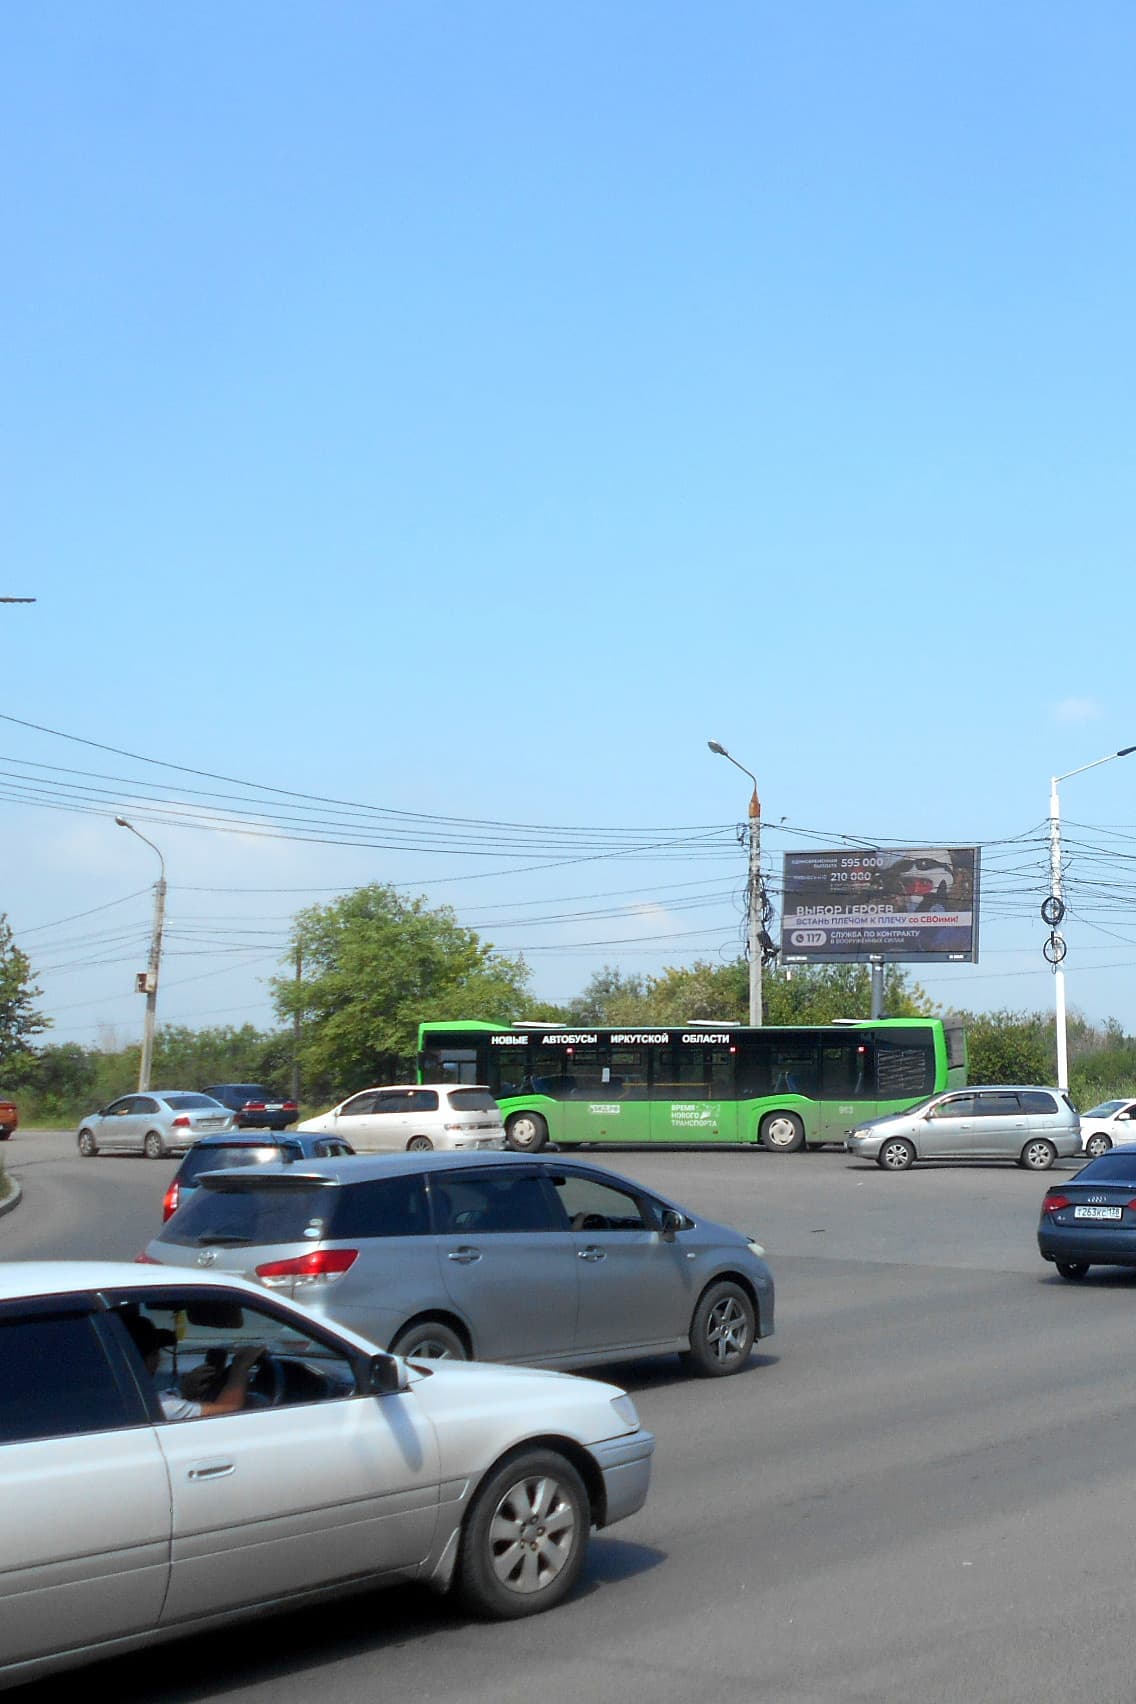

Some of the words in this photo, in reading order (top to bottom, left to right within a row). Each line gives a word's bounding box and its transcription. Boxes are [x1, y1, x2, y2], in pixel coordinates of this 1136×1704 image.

[840, 858, 860, 867] 595
[862, 857, 884, 867] 000
[830, 872, 848, 881] 210
[850, 871, 871, 881] 000
[796, 905, 842, 916] ВЫБОР
[845, 904, 894, 915] ГЕРОЕВ
[796, 917, 830, 926] ВСТАНЬ
[831, 917, 868, 926] ПЛЕЧОМ
[870, 917, 876, 925] К
[877, 916, 907, 925] ПЛЕЧУ
[806, 933, 821, 944] 117
[830, 931, 862, 939] СЛУЖБА
[863, 930, 875, 938] ПО
[876, 930, 921, 938] КОНТРАКТУ
[491, 1035, 529, 1045] НОВЫЕ
[542, 1034, 598, 1044] АВТОБУСЫ
[610, 1032, 669, 1044] ИРКУТСКОЙ
[681, 1034, 730, 1044] ОБЛАСТИ
[671, 1119, 718, 1127] ТРАНСПОРТА
